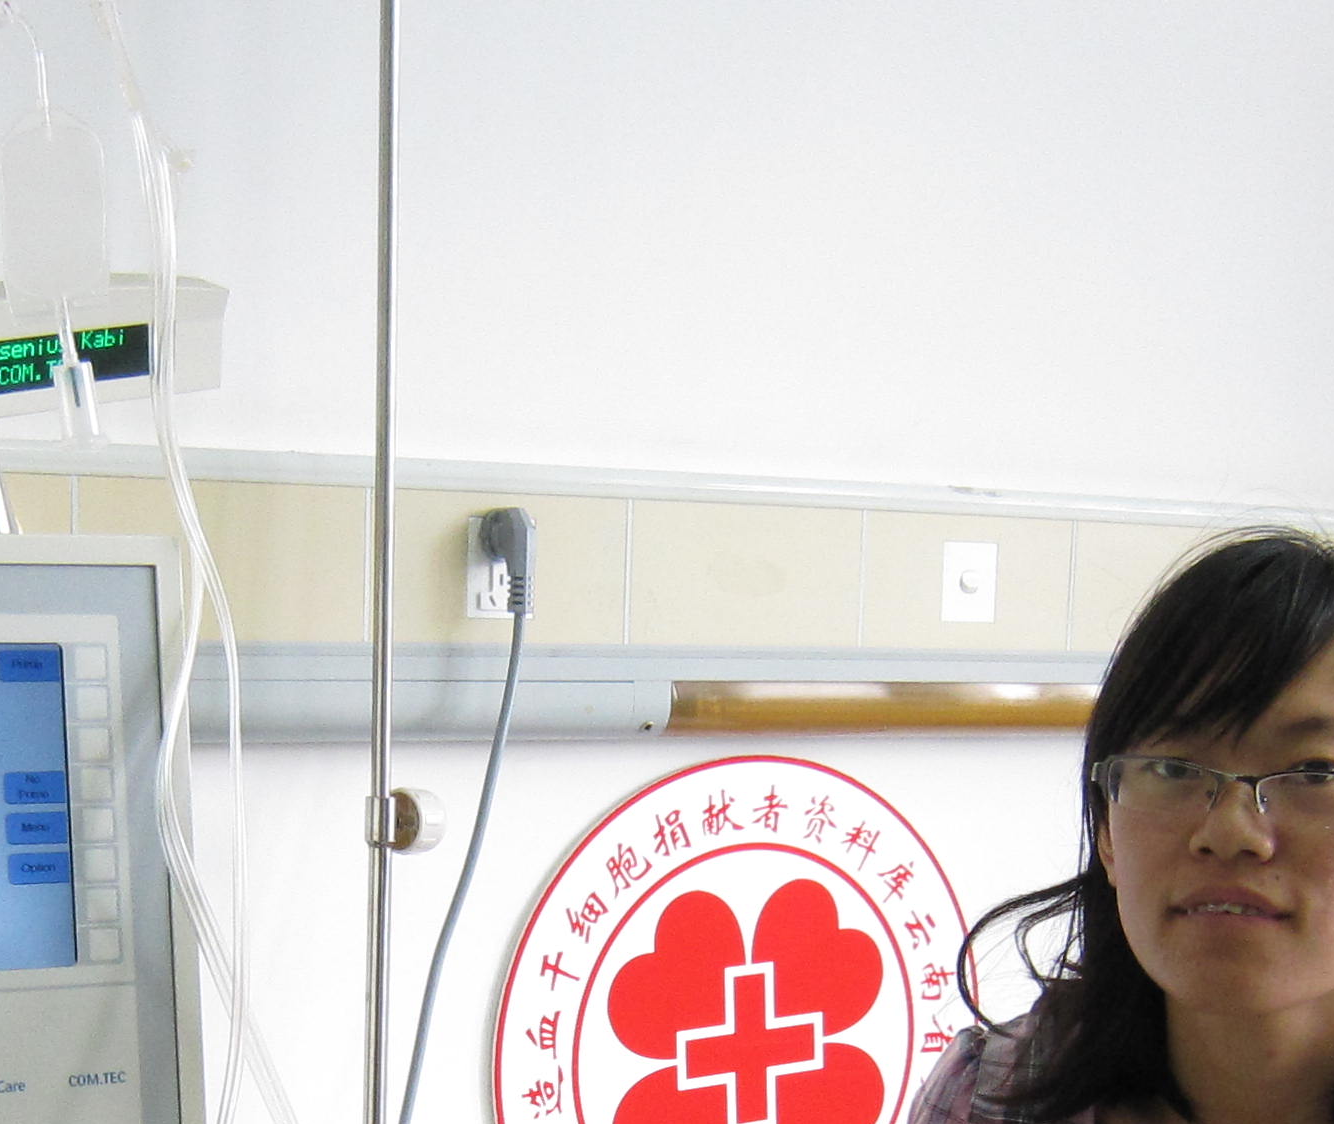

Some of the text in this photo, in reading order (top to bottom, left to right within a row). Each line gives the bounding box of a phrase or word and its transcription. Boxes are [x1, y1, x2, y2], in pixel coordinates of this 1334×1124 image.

[81, 329, 125, 350] Kabi
[20, 863, 56, 874] Option
[68, 1071, 127, 1088] COM.TEC
